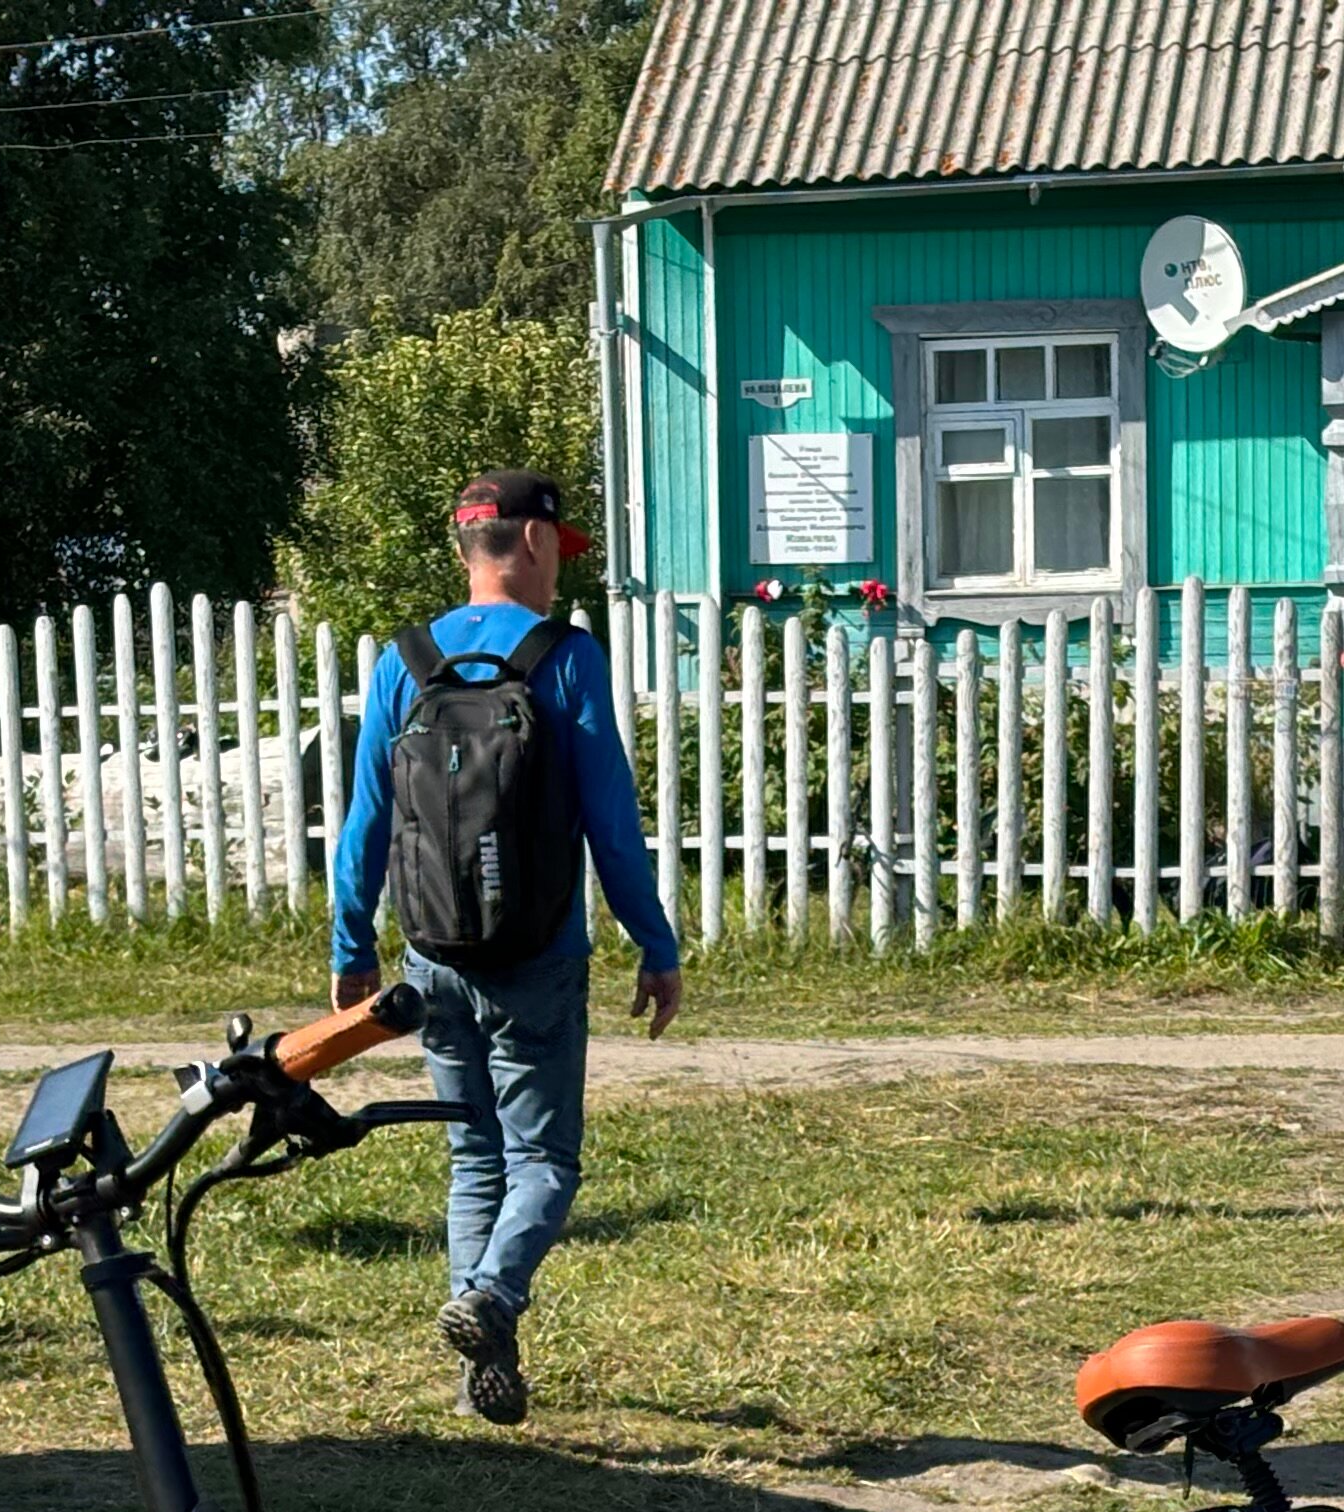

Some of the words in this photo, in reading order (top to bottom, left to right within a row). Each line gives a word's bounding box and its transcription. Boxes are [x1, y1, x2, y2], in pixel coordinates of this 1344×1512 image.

[1181, 258, 1207, 275] НТВ
[1184, 274, 1223, 290] ПЛЮС
[479, 831, 502, 902] THULE
